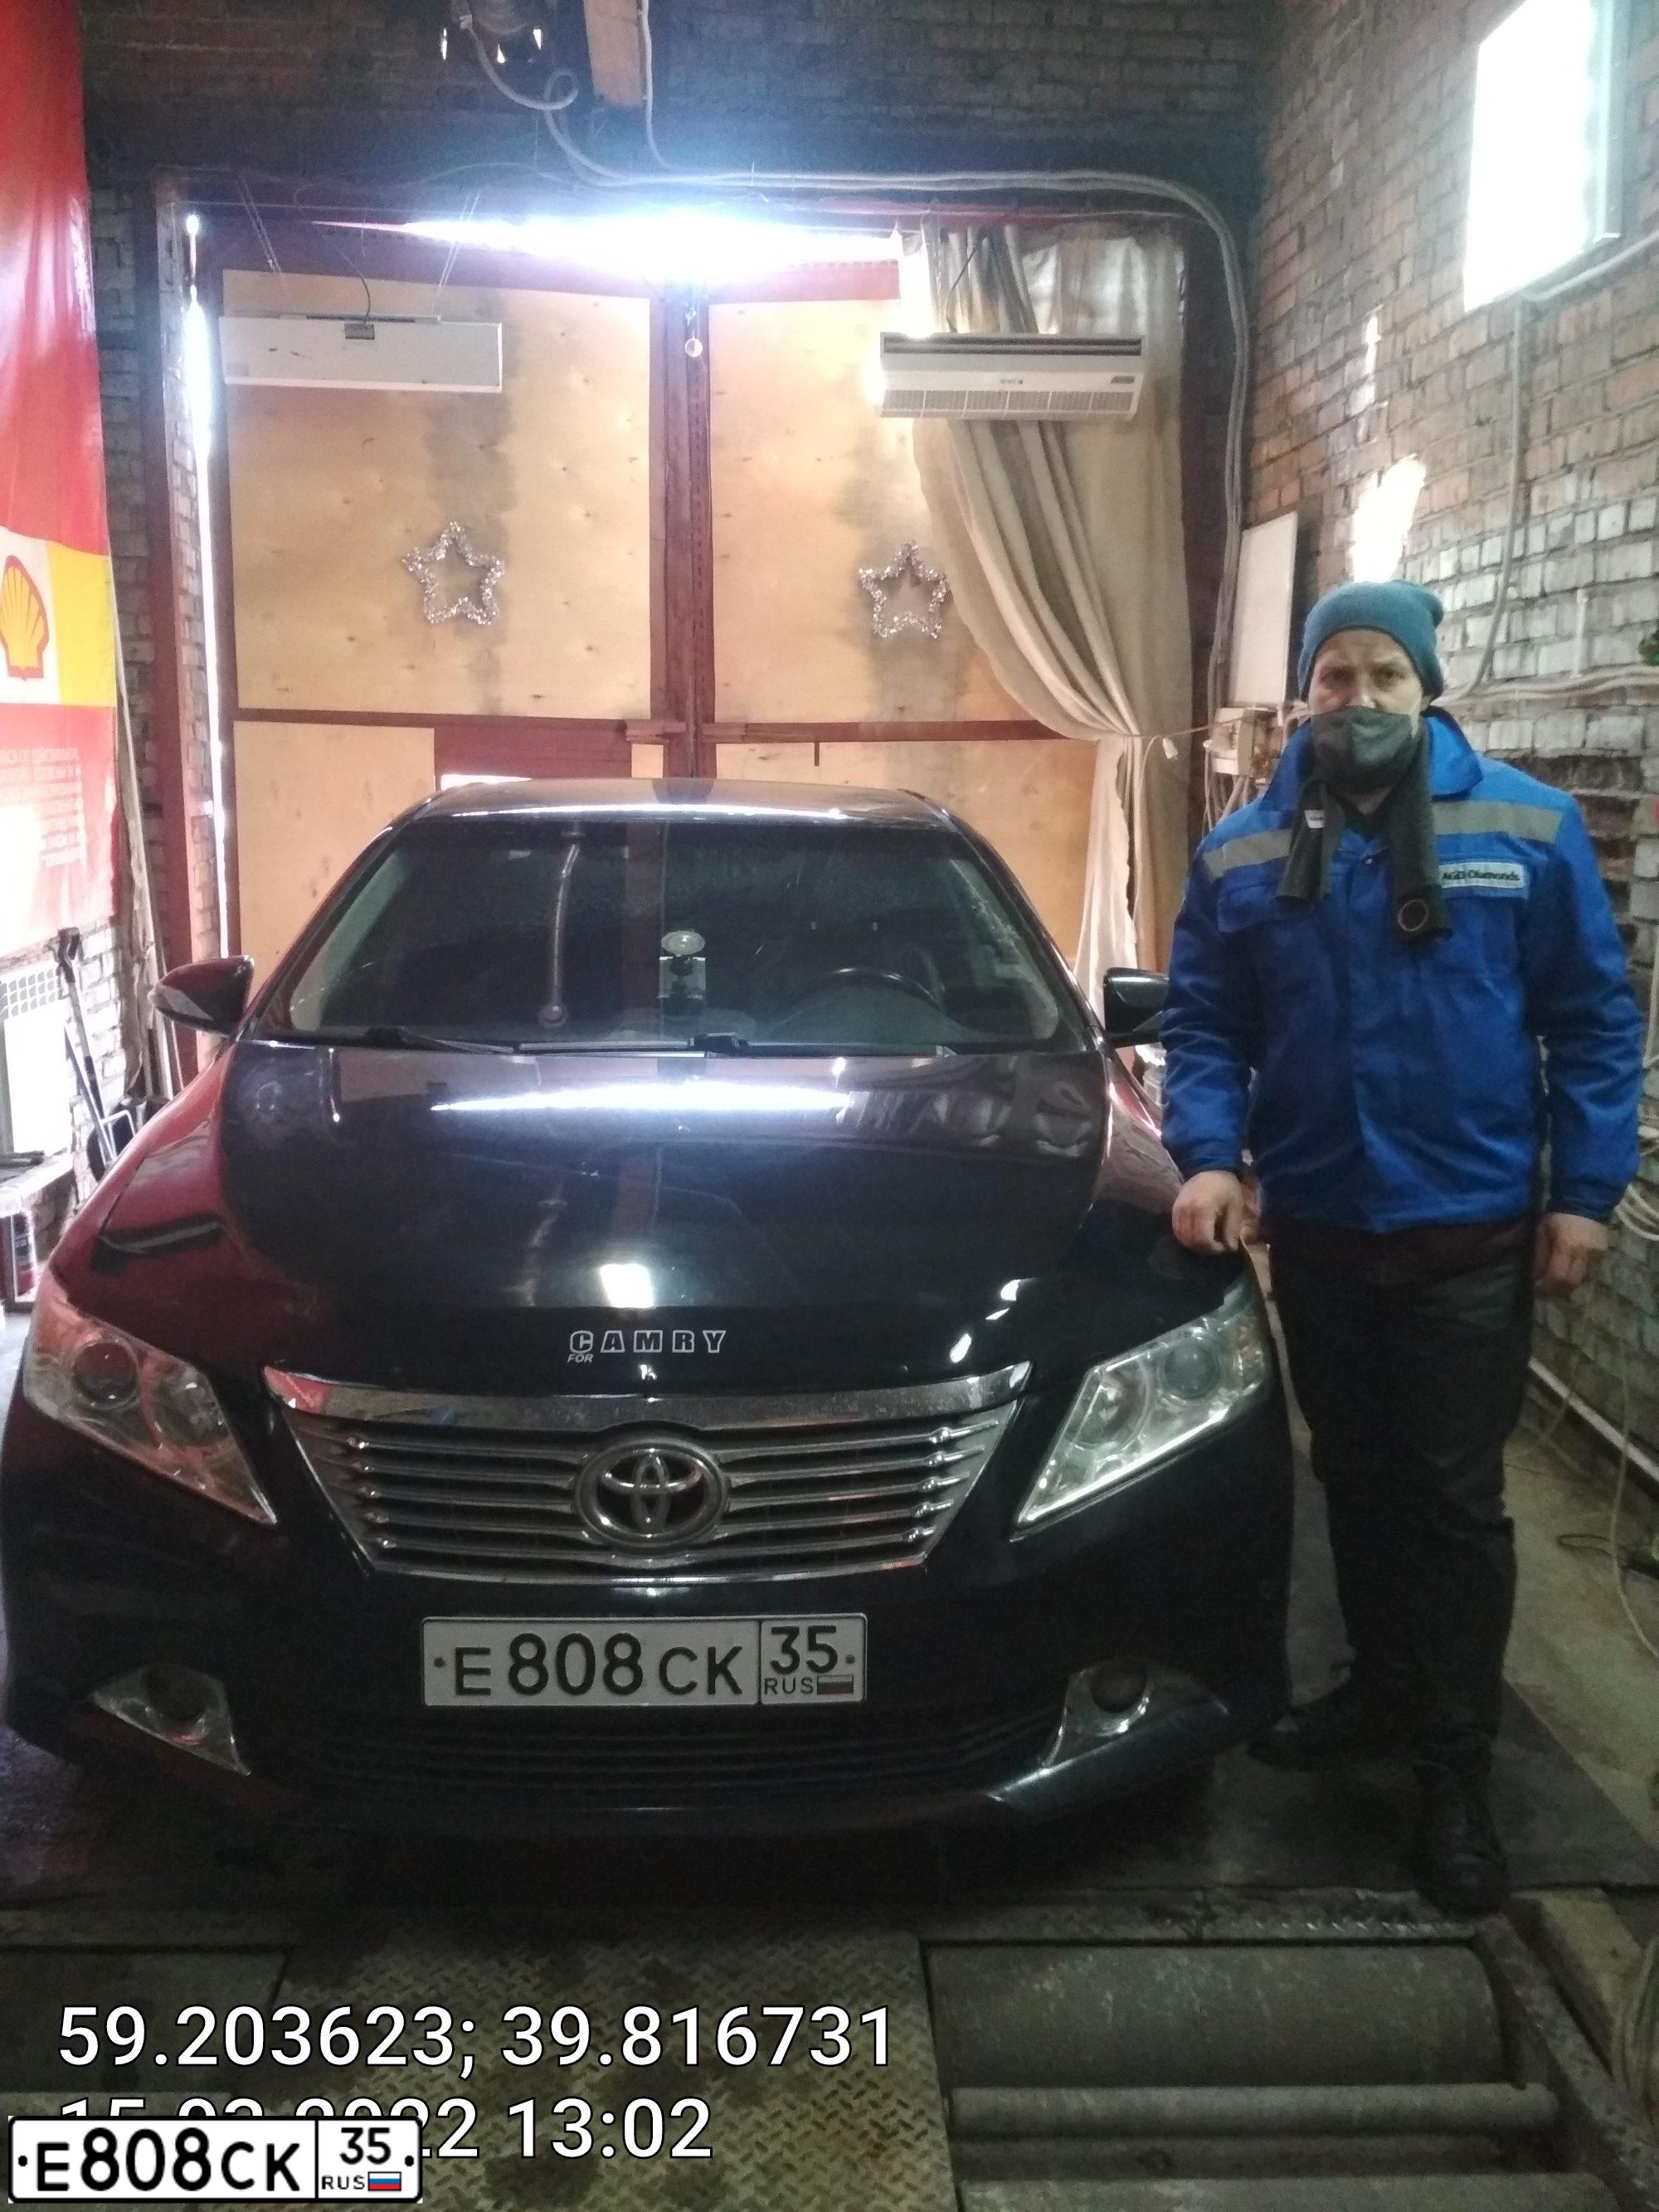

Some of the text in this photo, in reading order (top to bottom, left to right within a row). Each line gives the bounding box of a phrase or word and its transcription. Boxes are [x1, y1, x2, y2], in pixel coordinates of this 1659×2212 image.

[569, 1329, 727, 1354] CAMRY
[567, 1353, 594, 1364] FOR
[770, 1625, 839, 1674] 35
[763, 1677, 815, 1695] RUS
